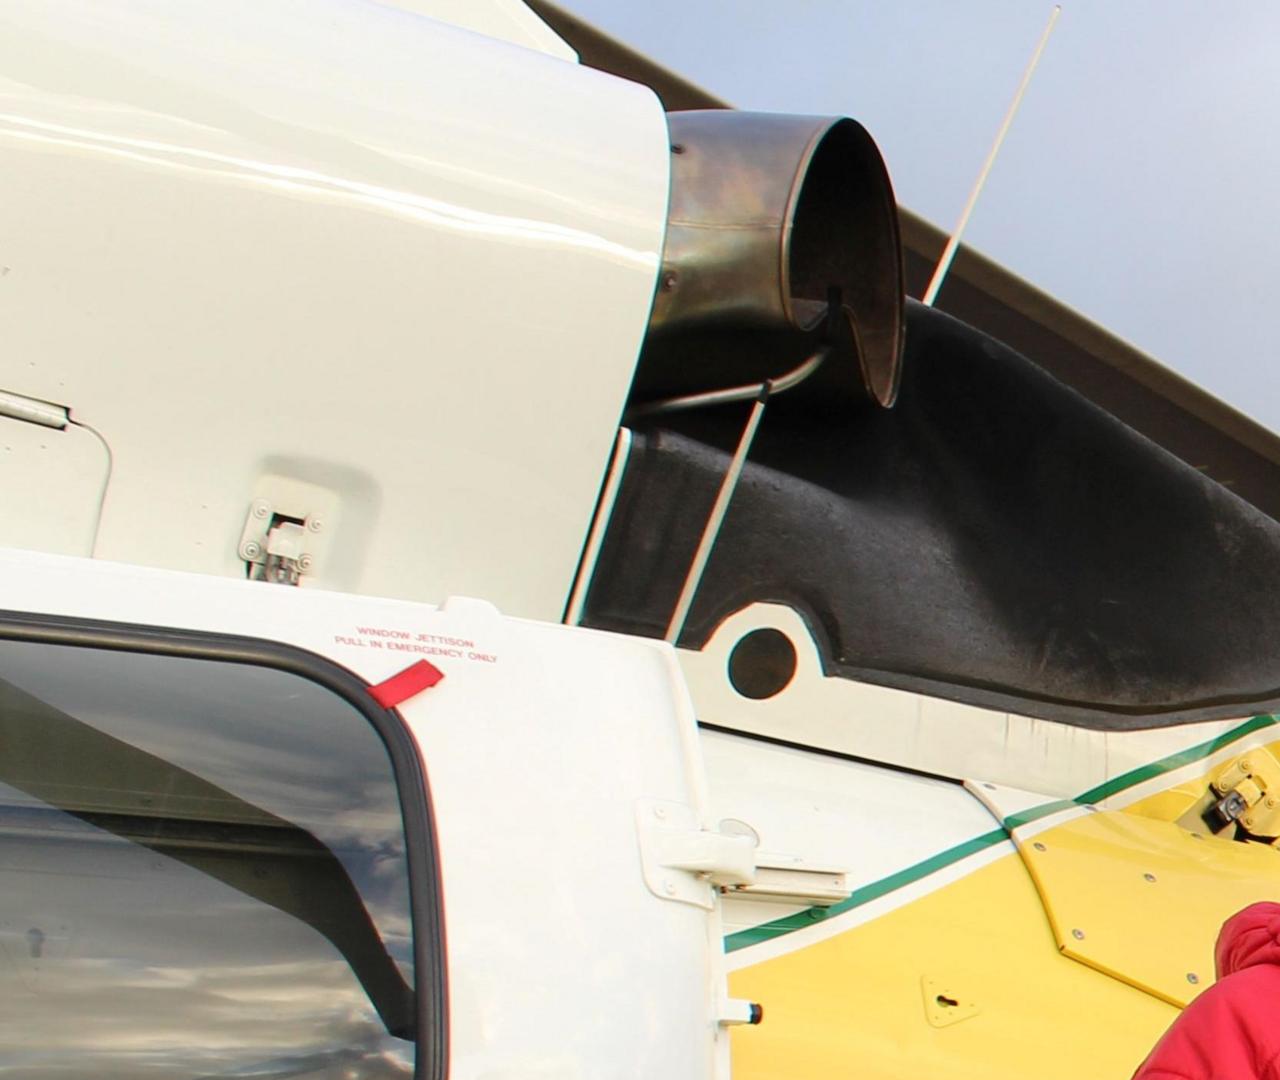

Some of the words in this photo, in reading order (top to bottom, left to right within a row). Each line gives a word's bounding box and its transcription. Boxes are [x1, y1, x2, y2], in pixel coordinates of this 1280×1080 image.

[334, 635, 366, 647] PULL
[370, 640, 383, 649] IN
[387, 642, 464, 659] EMERGENCY
[468, 653, 497, 664] ONLY
[356, 626, 410, 640] WINDOW
[416, 634, 475, 649] JETTISON
